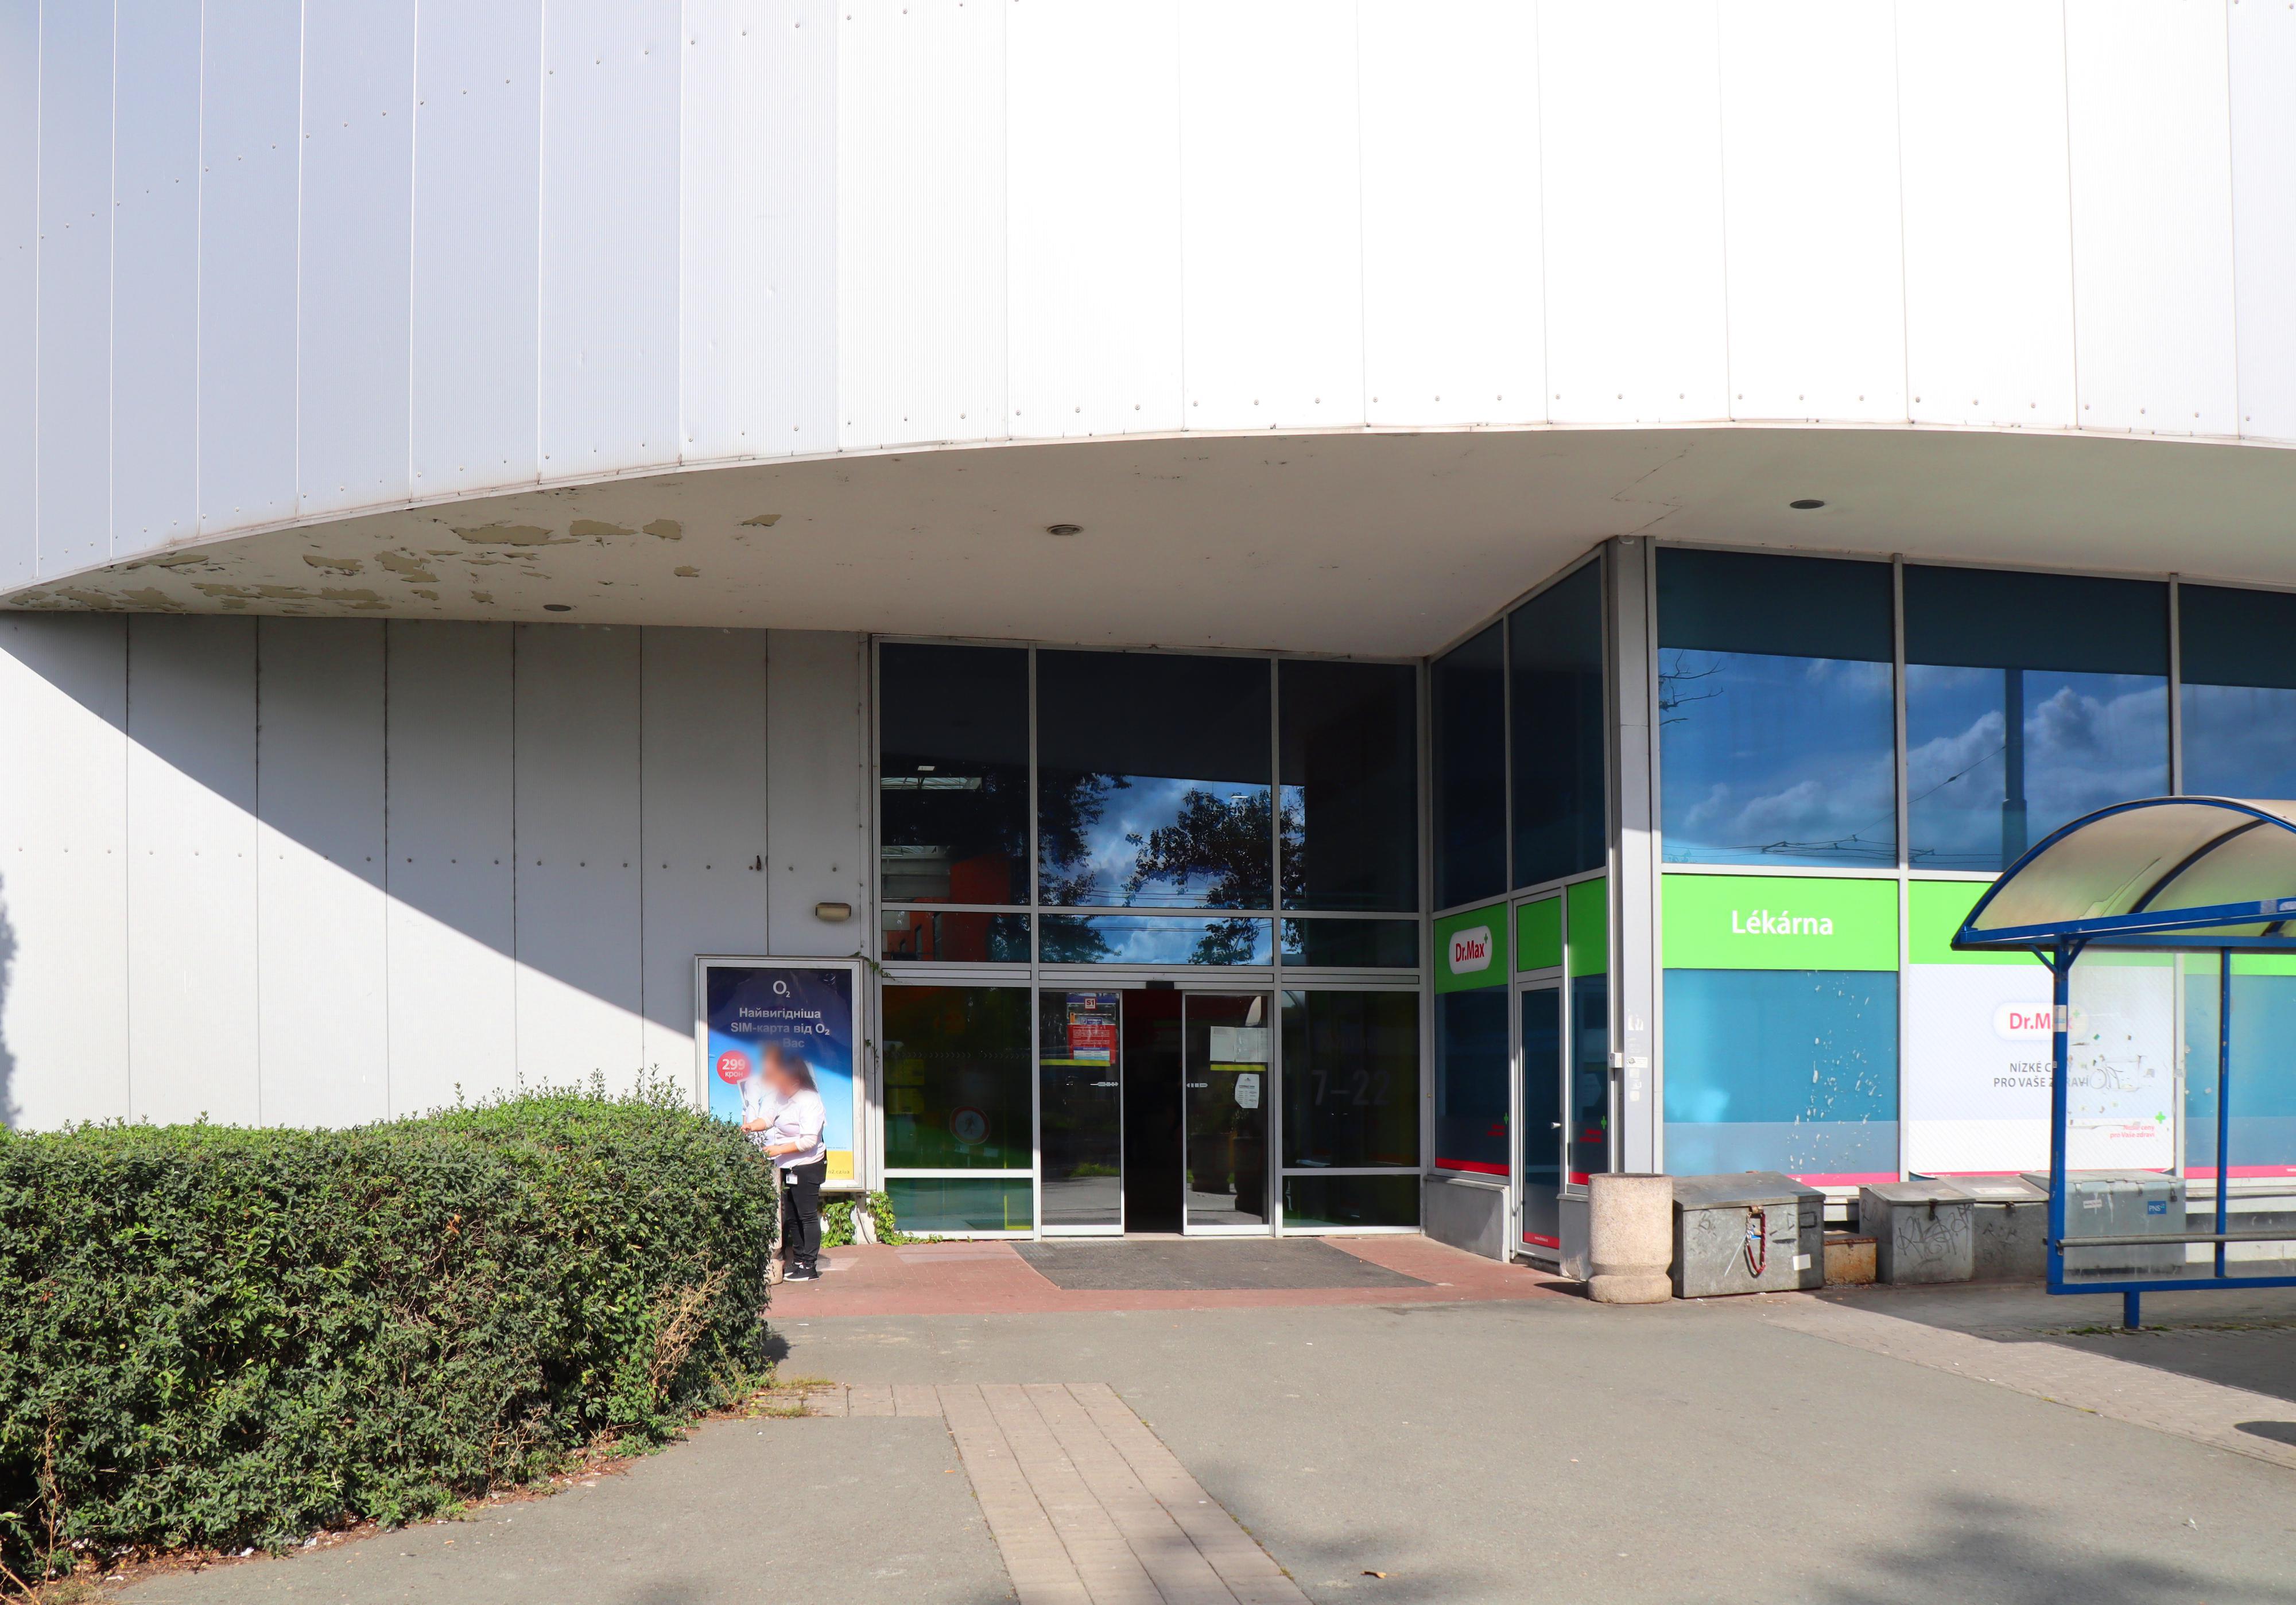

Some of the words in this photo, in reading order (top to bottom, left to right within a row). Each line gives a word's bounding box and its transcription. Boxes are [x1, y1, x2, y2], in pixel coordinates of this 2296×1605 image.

[1732, 909, 1833, 935] Lékárna
[1455, 940, 1484, 962] Dr.Max
[773, 980, 790, 998] O2
[739, 1007, 821, 1020] Найвигідніша
[2009, 1013, 2073, 1029] Dr.M
[731, 1022, 790, 1035] SIM-карта
[793, 1023, 812, 1035] від
[815, 1023, 830, 1035] O2
[782, 1037, 805, 1048] Вас
[722, 1059, 746, 1070] 299
[2010, 1061, 2042, 1072] NÍZKÉ
[1994, 1078, 2015, 1087] PRO
[2018, 1075, 2045, 1087] VAŠE
[2049, 1075, 2089, 1087] ZRAVÍ
